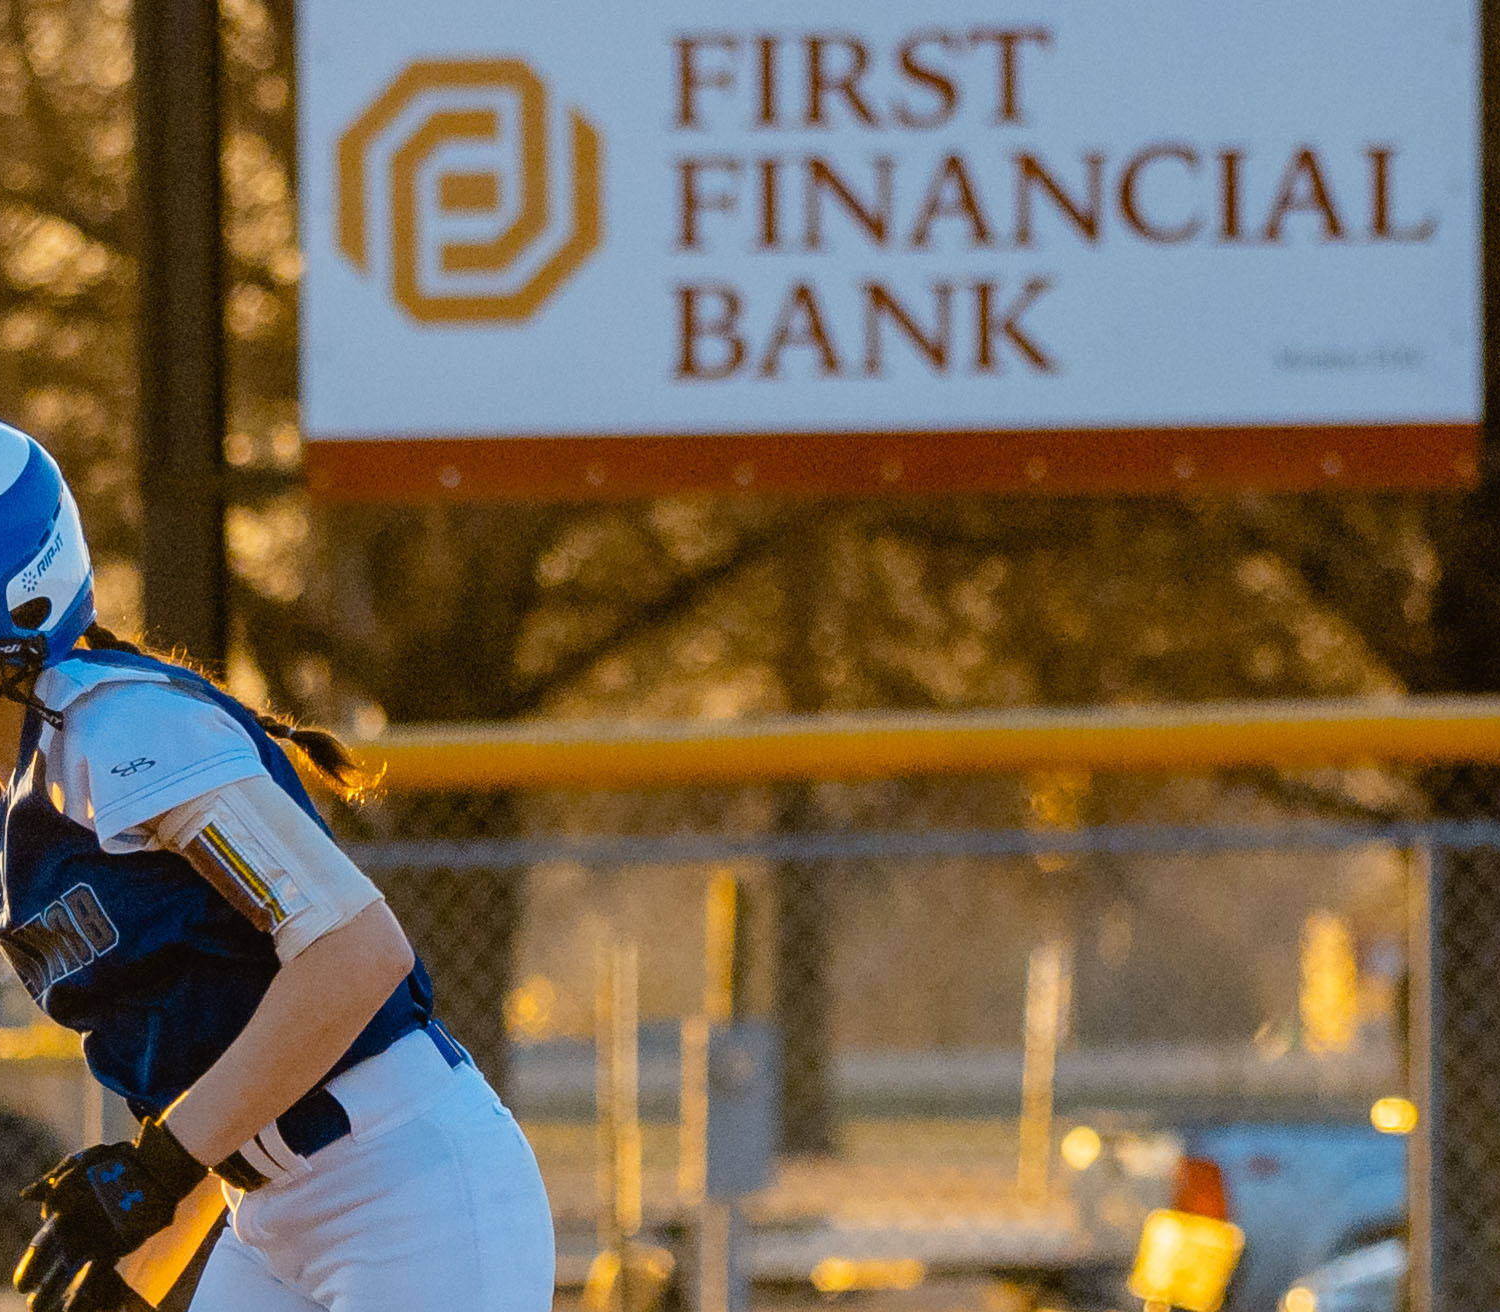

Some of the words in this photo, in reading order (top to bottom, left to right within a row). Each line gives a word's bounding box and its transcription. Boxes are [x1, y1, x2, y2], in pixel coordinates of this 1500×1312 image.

[669, 28, 1055, 131] FIRST
[671, 143, 1437, 252] FINANCIAL
[670, 274, 1059, 382] BANK
[36, 532, 64, 577] RIP-IT
